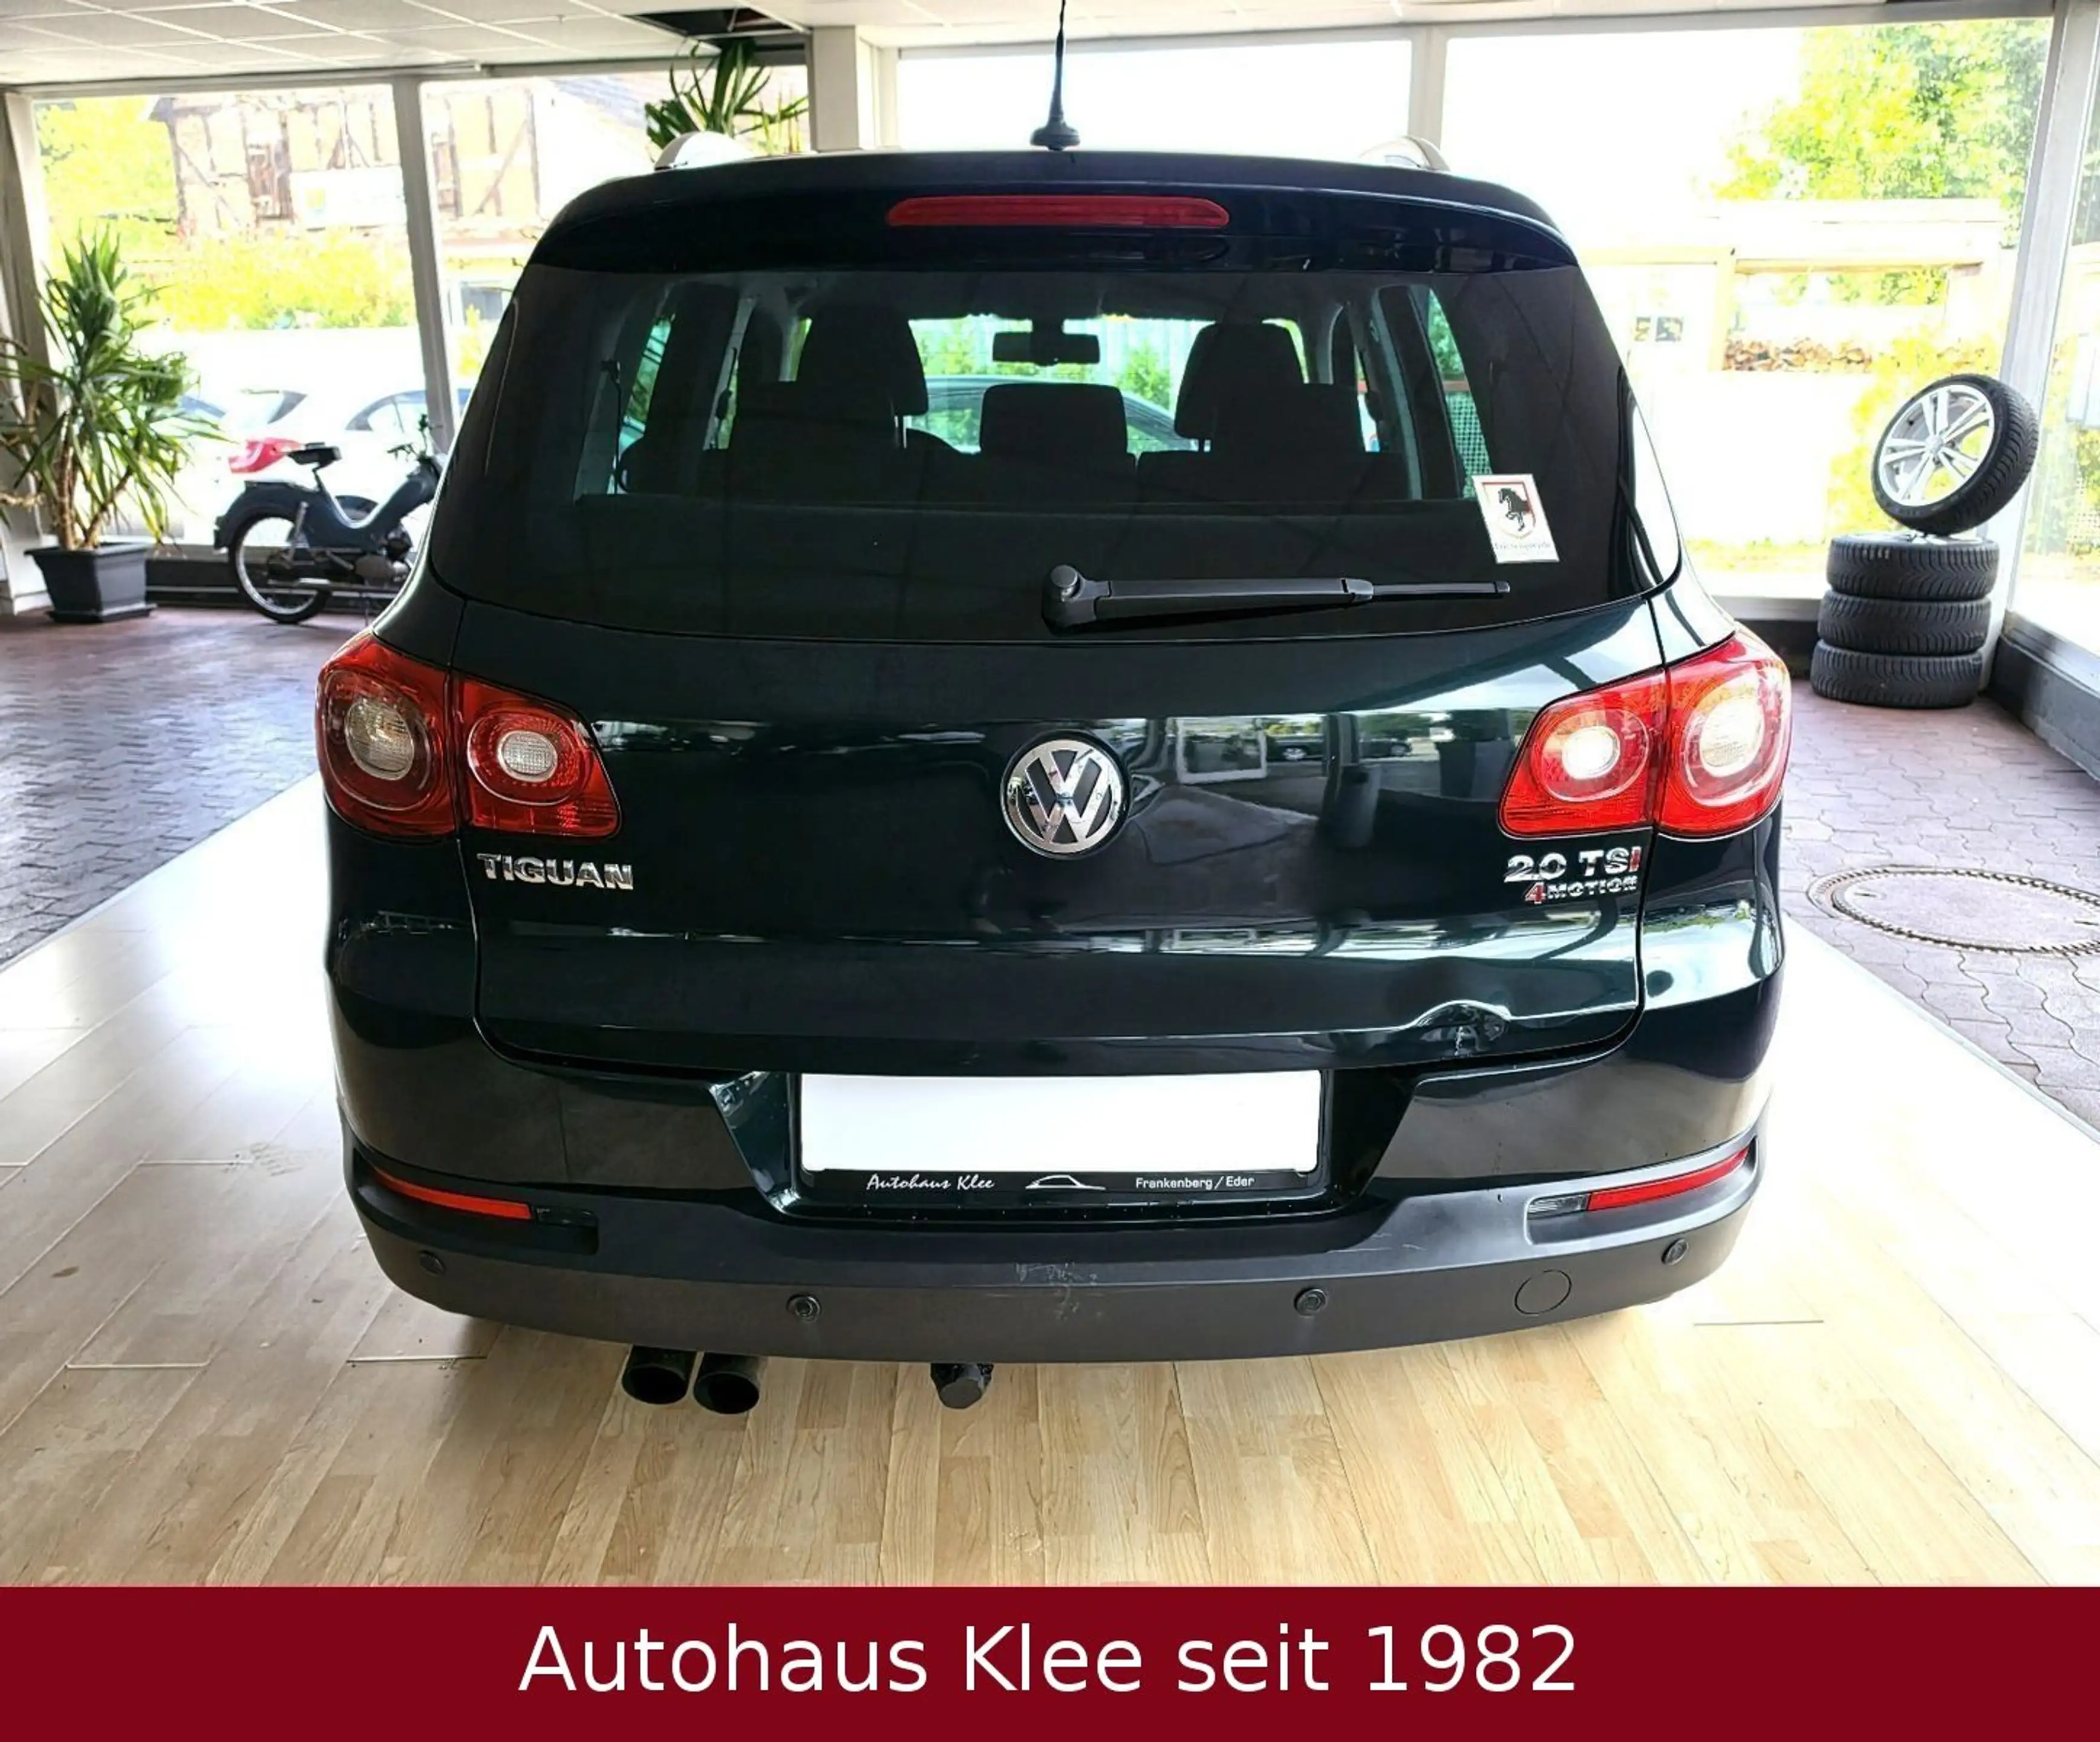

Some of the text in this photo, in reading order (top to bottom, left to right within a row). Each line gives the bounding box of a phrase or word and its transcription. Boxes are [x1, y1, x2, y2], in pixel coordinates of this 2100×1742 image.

[477, 852, 634, 890] TIGUAN
[1578, 846, 1642, 876] TSI
[1524, 875, 1638, 904] 4MOTION
[866, 1172, 995, 1190] Autohaus Klee
